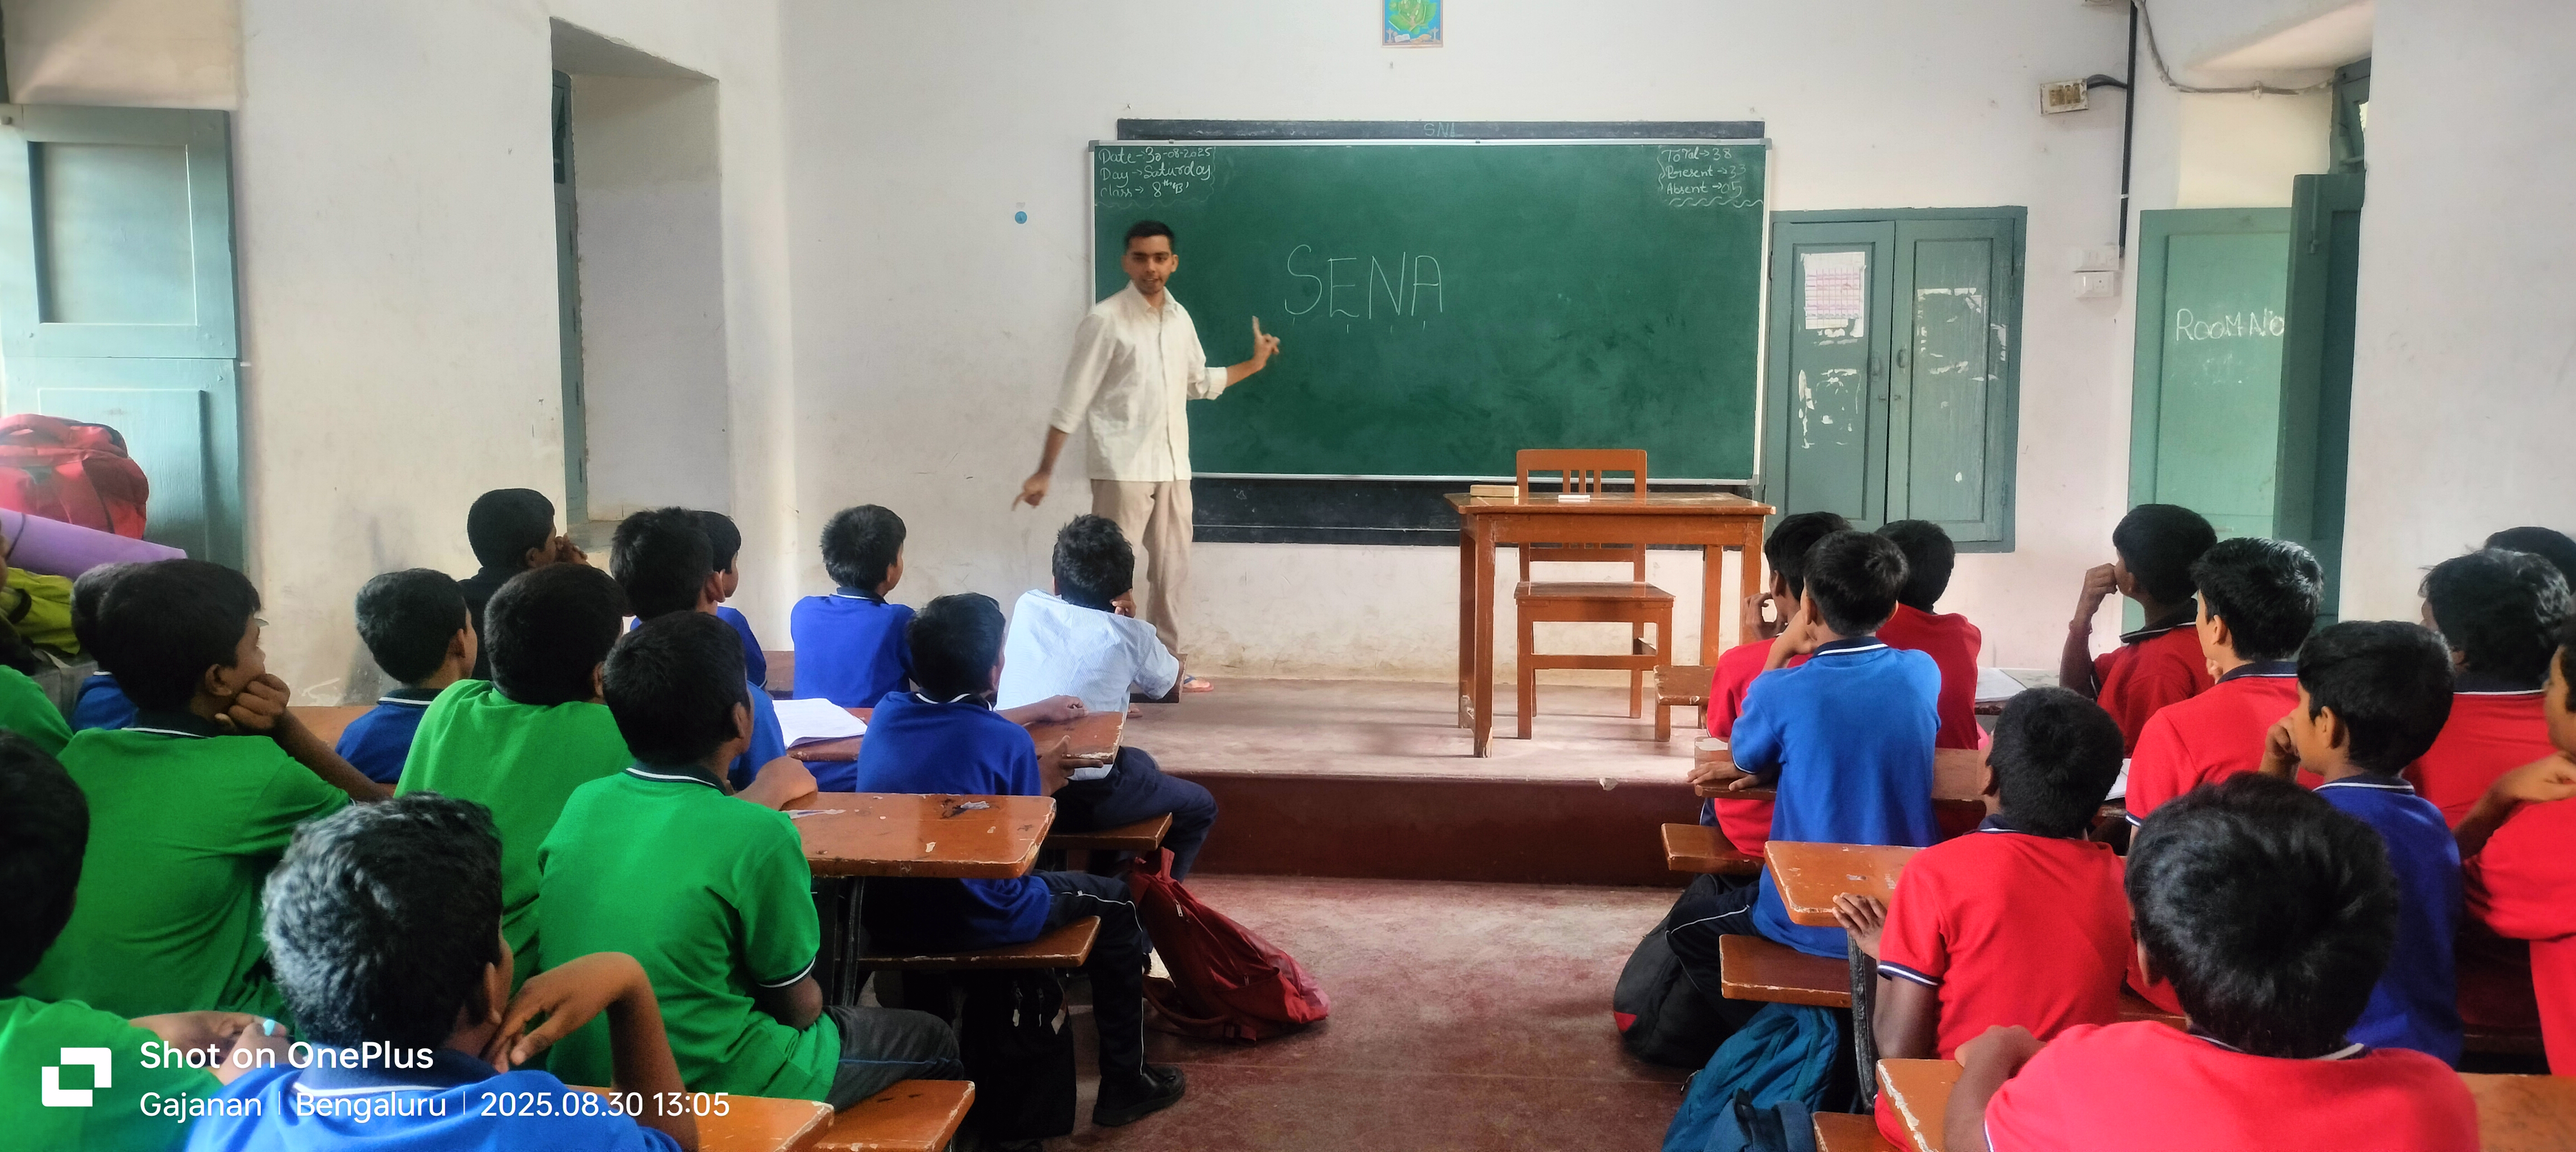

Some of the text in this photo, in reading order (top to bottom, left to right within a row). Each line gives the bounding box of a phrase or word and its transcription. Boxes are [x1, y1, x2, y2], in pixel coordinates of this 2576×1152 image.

[1099, 147, 1136, 164] Date
[1712, 148, 1732, 161] 38
[1100, 160, 1211, 188] Day Saturday
[1666, 165, 1713, 179] Present
[1667, 181, 1709, 195] Absent
[1284, 243, 1443, 320] SENA
